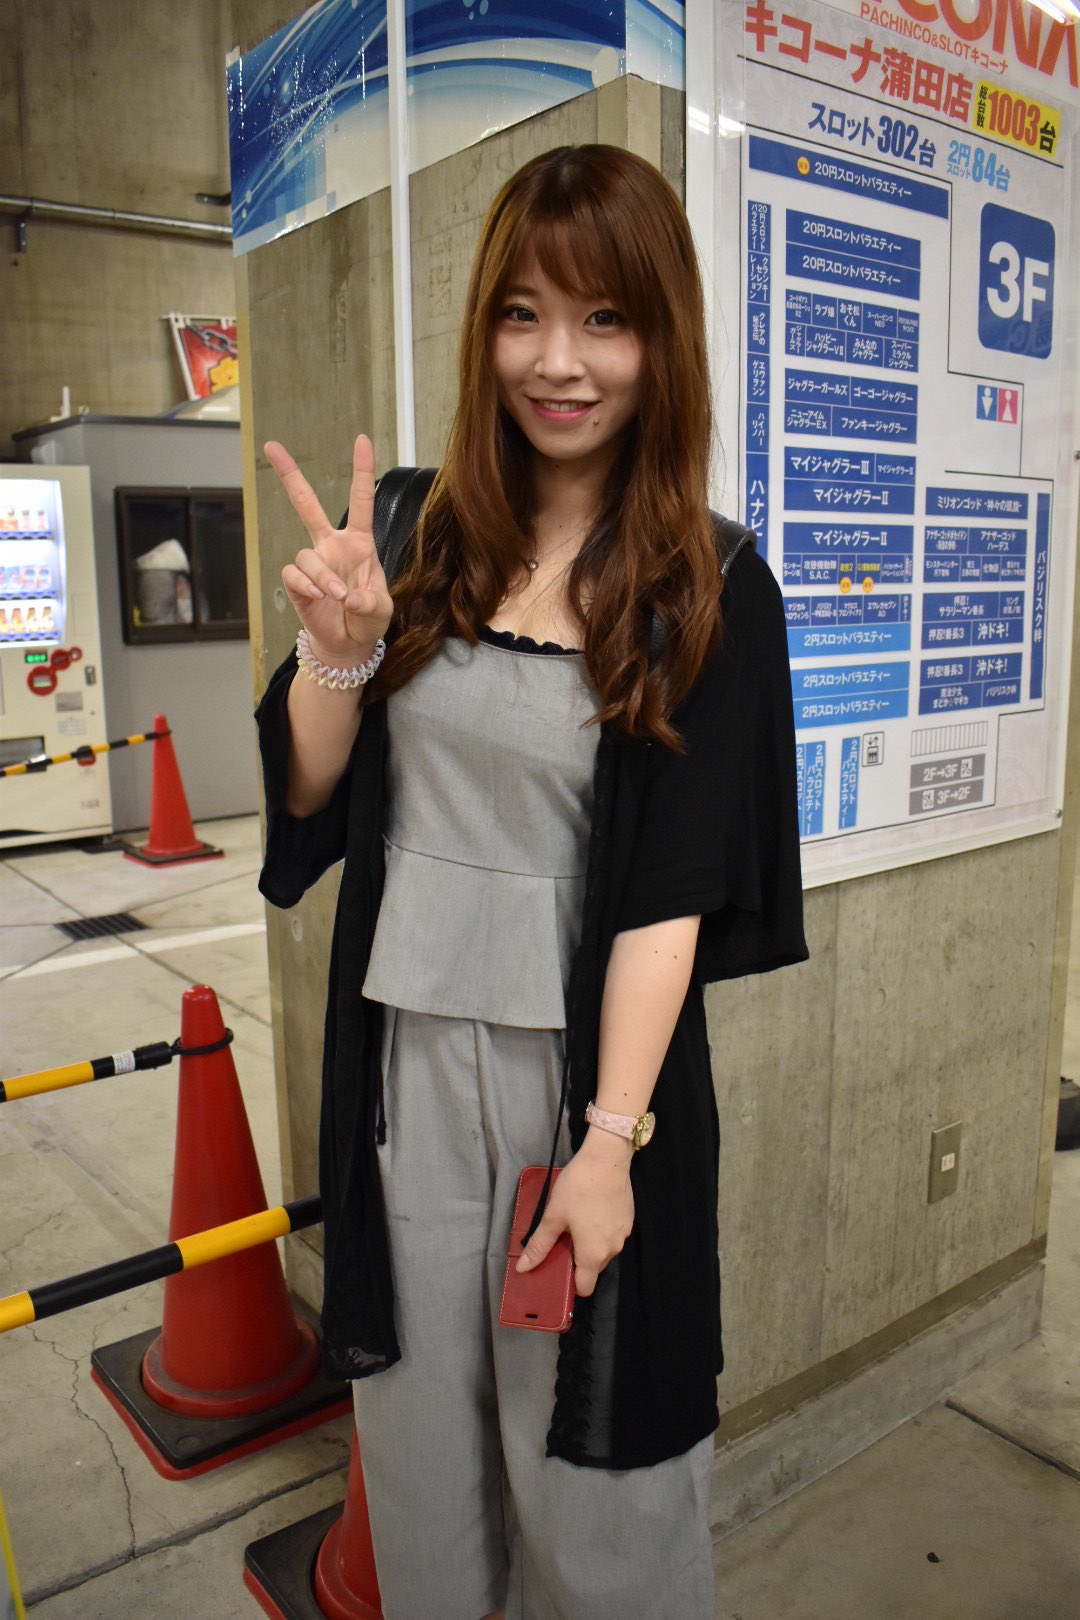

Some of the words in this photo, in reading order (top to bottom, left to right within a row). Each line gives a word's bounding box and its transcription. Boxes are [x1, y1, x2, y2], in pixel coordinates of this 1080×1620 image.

[745, 0, 973, 122] キコーナ蒲田店
[814, 162, 912, 197] 20円スロットバラエティー
[802, 220, 902, 253] 20円スロットバラエティー
[802, 255, 901, 286] 20円スロットバラエティー
[986, 241, 1049, 322] 3F
[844, 315, 856, 327] くん
[814, 332, 837, 344] ハッピー
[854, 338, 877, 351] みんなの
[891, 340, 912, 350] スーパー
[852, 347, 880, 361] ジャグラー
[891, 349, 911, 360] ミラクル
[888, 357, 914, 371] ジャグラー
[788, 379, 847, 396] ジャグラーガールズ
[853, 387, 913, 404] ゴーゴージャグラー
[787, 418, 827, 430] ジャグラーEX
[841, 417, 908, 434] ファンキージャグラー
[937, 496, 982, 510] ミリオンゴッド
[981, 531, 1016, 541] アナザーゴッド
[987, 542, 1009, 551] ハーデス
[1034, 551, 1047, 643] バジリスク絆
[939, 605, 984, 616] サラリーマン番長
[804, 633, 893, 647] 2円スロットバラエティー
[803, 671, 891, 688] 2円スロットバラエティー
[802, 700, 890, 718] 2円スロットバラエティー
[815, 744, 823, 810] 2円スロット
[849, 740, 858, 805] 2円スロット
[805, 764, 815, 834] バラエティー
[841, 759, 850, 827] バラエティー
